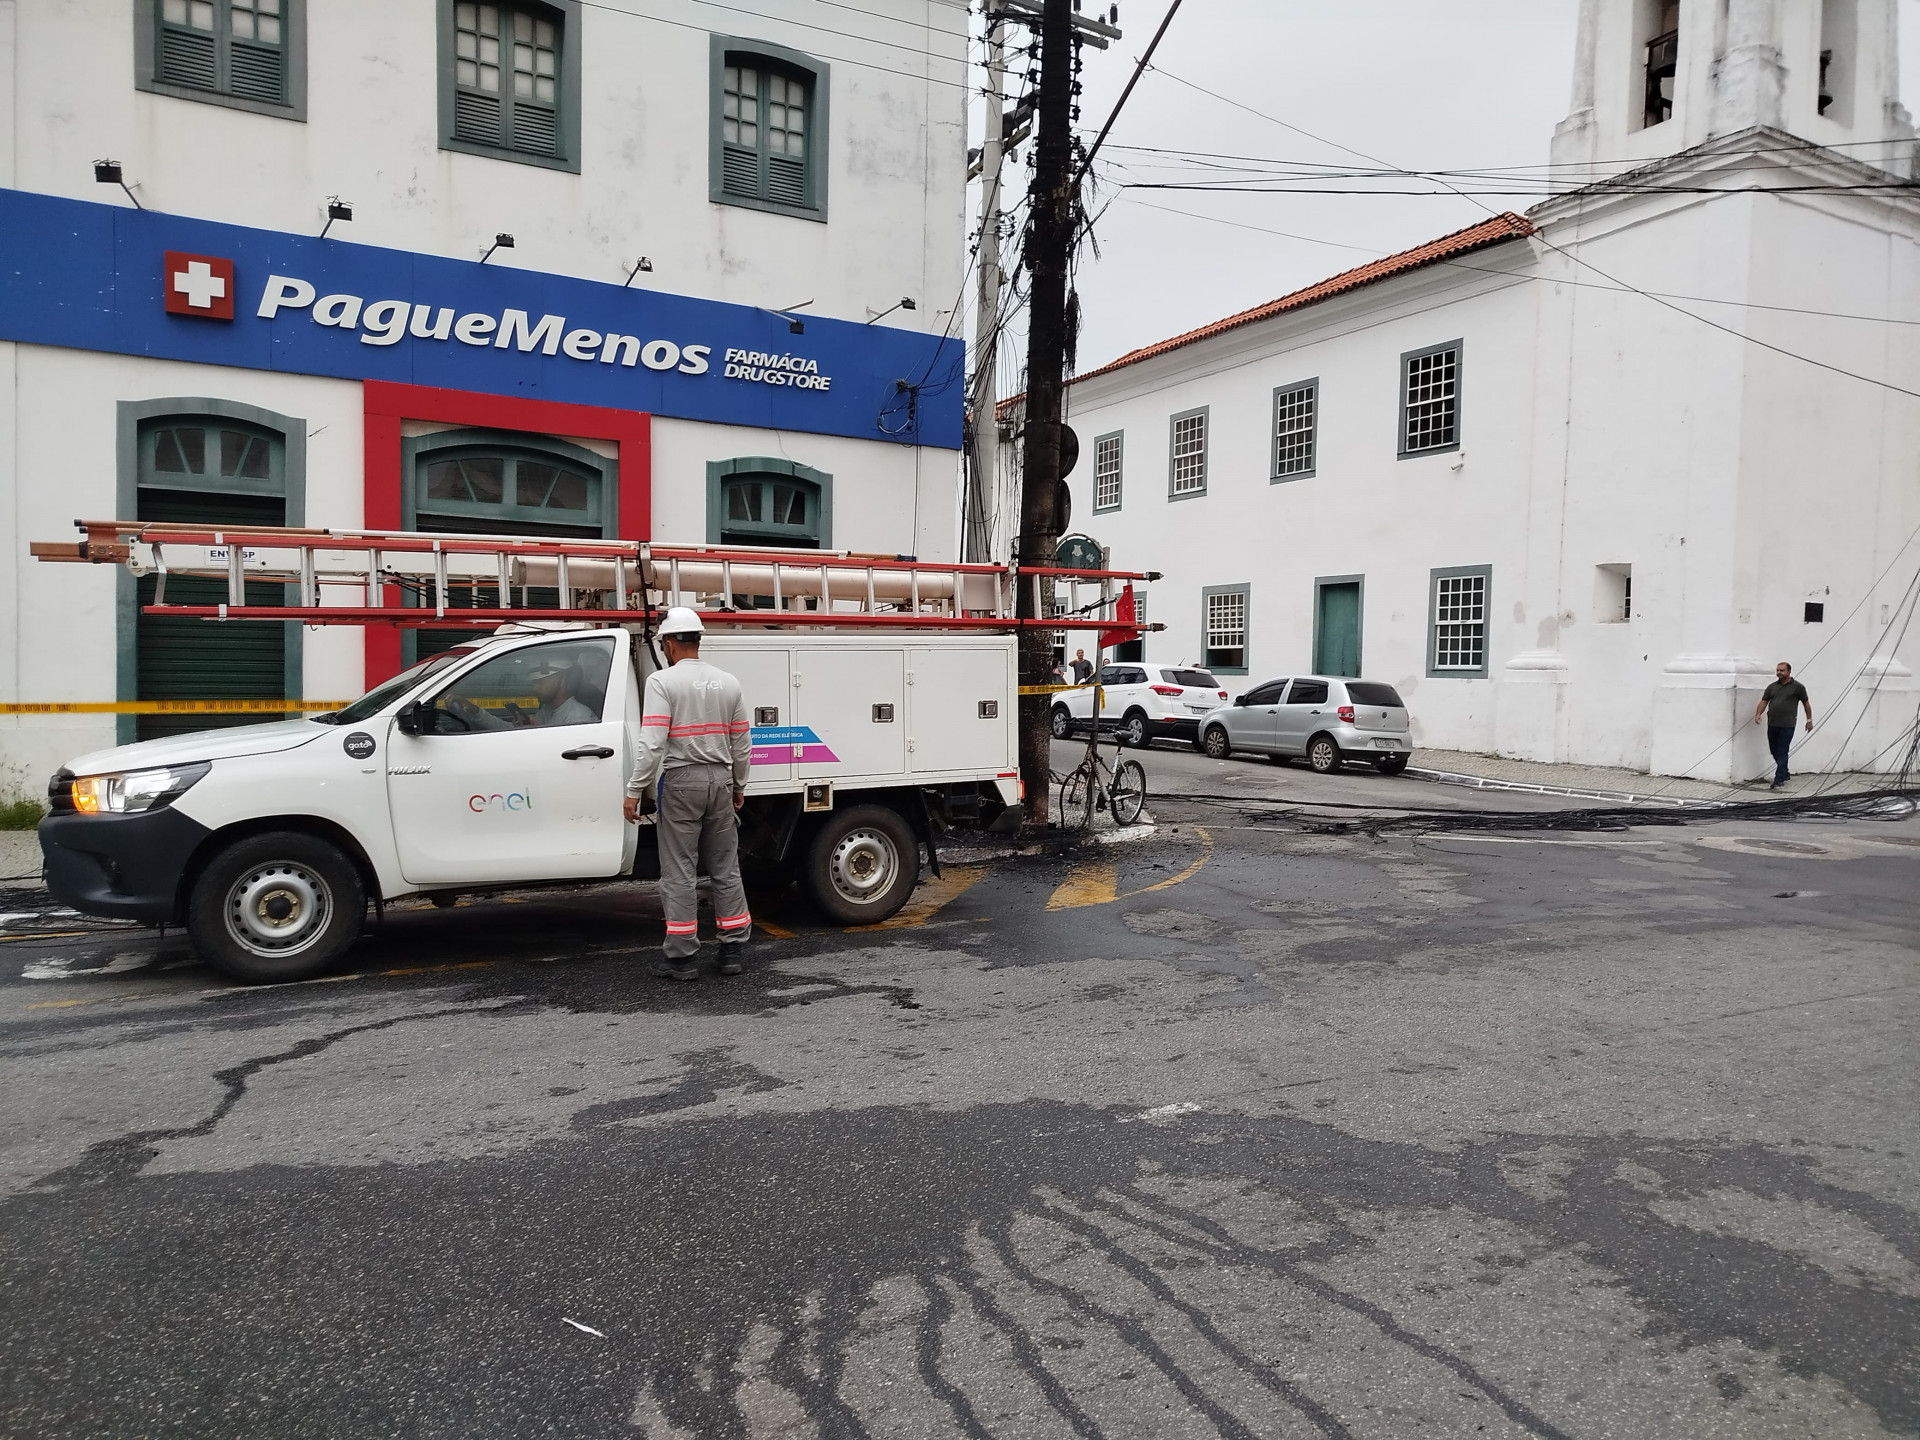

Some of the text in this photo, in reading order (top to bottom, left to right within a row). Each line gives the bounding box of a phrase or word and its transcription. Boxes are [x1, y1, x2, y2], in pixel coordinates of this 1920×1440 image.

[256, 274, 711, 375] PagueMenos
[724, 347, 818, 374] FARMÁCIA
[723, 363, 832, 391] DRUGSTORE
[388, 765, 432, 776] HILUX
[468, 786, 532, 813] enel
